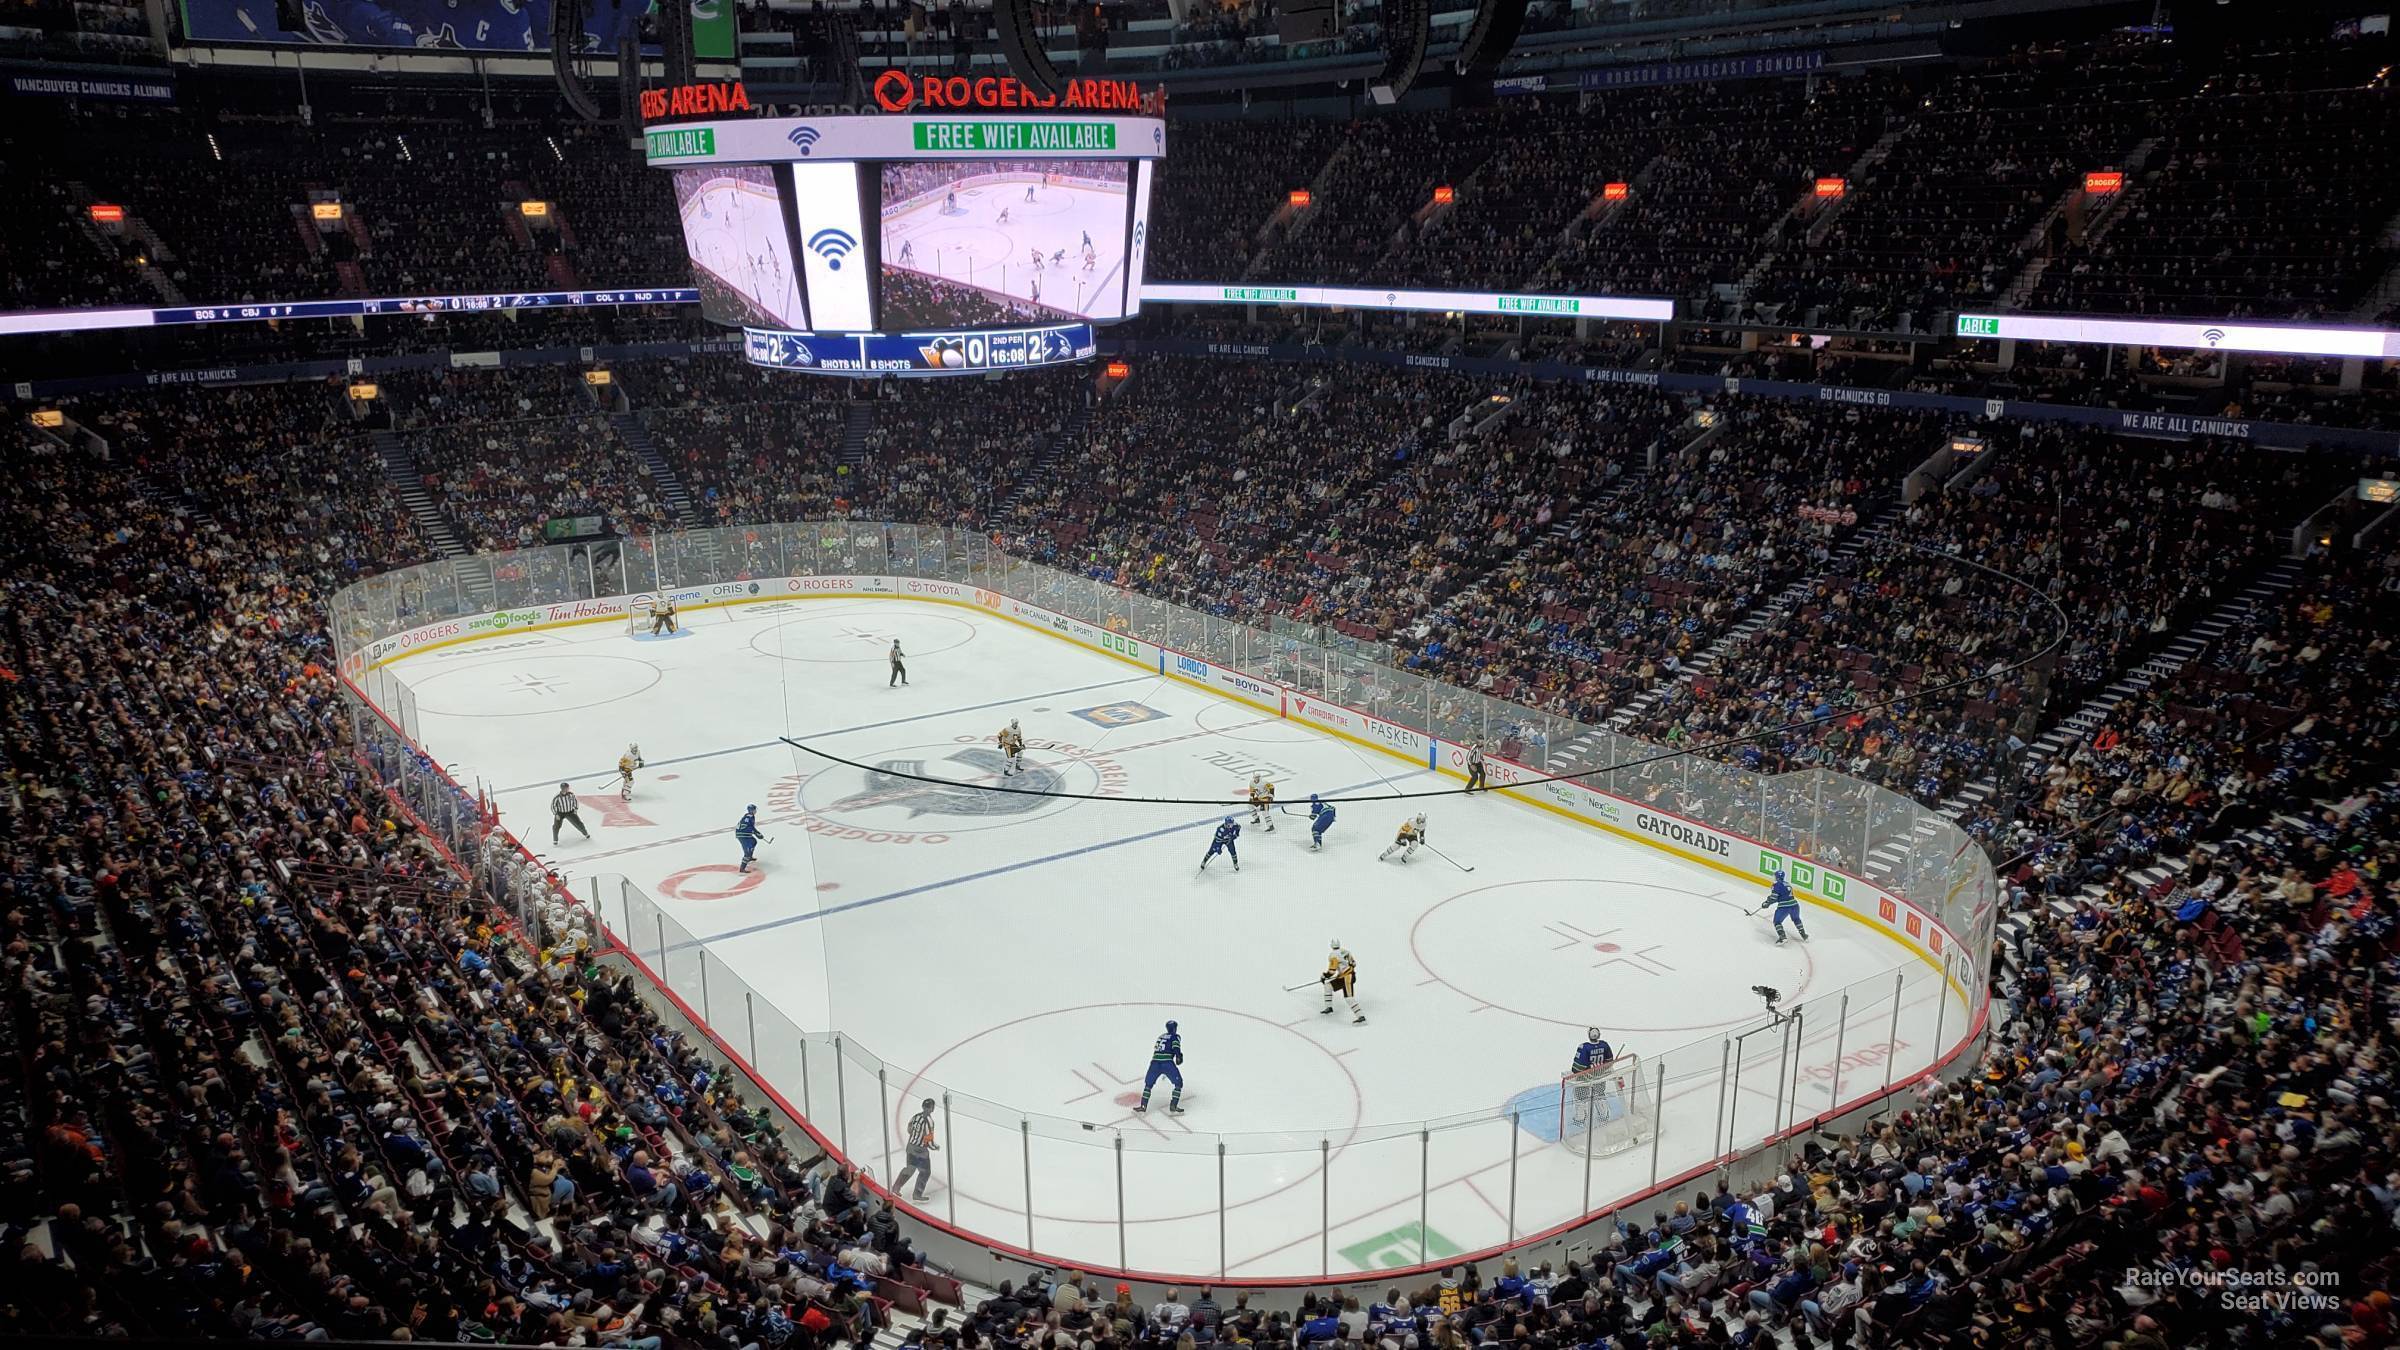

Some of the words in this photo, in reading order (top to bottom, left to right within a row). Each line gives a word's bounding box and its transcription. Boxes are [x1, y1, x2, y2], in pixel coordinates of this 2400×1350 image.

[1666, 60, 1746, 79] BROADCAST
[1755, 54, 1823, 73] GONDOLA
[14, 78, 79, 94] VANCOUVER
[81, 81, 131, 96] CANUCKS
[133, 84, 172, 98] ALUMNI
[1065, 79, 1140, 109] ARENA
[670, 82, 750, 116] ARENA
[658, 130, 707, 156] AVAILABLE
[926, 124, 975, 148] FREE
[982, 124, 1023, 148] WIFI
[1029, 124, 1108, 149] AVAILABLE
[493, 297, 501, 307] 2
[596, 294, 612, 302] COL
[635, 292, 652, 301] NJD
[1260, 289, 1293, 300] AVAILABLE
[452, 299, 459, 309] 0
[1502, 297, 1518, 310] FREE
[1520, 298, 1536, 311] WIFI
[1538, 299, 1575, 312] AVAILABLE
[195, 310, 215, 320] BOS
[222, 309, 229, 318] 4
[242, 308, 260, 317] CBJ
[993, 337, 1007, 345] 2ND
[1009, 336, 1022, 344] PER
[1029, 336, 1041, 359] 2
[769, 338, 780, 363] 2
[968, 338, 984, 364] 0
[991, 348, 1024, 364] 16:08
[1220, 344, 1231, 353] ARE
[1233, 344, 1242, 353] ALL
[1244, 345, 1269, 355] CANUCKS
[821, 359, 849, 369] SHOTS
[851, 360, 860, 369] 14
[878, 360, 911, 369] SHOTS
[1406, 356, 1413, 366] GO
[1414, 356, 1439, 367] CANUCKS
[1441, 357, 1450, 368] GO
[146, 374, 158, 385] WE
[161, 373, 179, 383] ARE
[180, 372, 195, 382] ALL
[197, 369, 237, 382] CANUCKS
[1585, 368, 1596, 380] WE
[1597, 369, 1611, 381] ARE
[1612, 370, 1624, 382] ALL
[1625, 372, 1658, 385] CANUCKS
[1820, 388, 1832, 400] GO
[1835, 389, 1875, 404] CANUCKS
[1878, 392, 1890, 405] GO
[2122, 413, 2138, 428] WE
[2142, 416, 2164, 430] ARE
[2168, 418, 2187, 432] ALL
[2192, 420, 2249, 437] CANUCKS
[713, 583, 743, 595] ORIS
[804, 579, 853, 589] ROGERS
[924, 583, 960, 597] TOYOTA
[547, 603, 571, 622] Tim
[574, 600, 622, 619] Hortons
[1030, 609, 1051, 624] CANADA
[413, 623, 460, 644] ROGERS
[1073, 624, 1093, 638] SPORTS
[1177, 656, 1208, 677] LORDCO
[1235, 678, 1260, 692] BOYD
[1308, 706, 1337, 724] CANADIAN
[1338, 715, 1348, 727] TIRE
[1371, 721, 1419, 748] FASKEN
[1546, 783, 1575, 799] NexGen
[1589, 797, 1620, 815] NexGen
[1636, 813, 1730, 857] GATORADE
[1793, 864, 1812, 883] TD
[1825, 876, 1843, 895] TD
